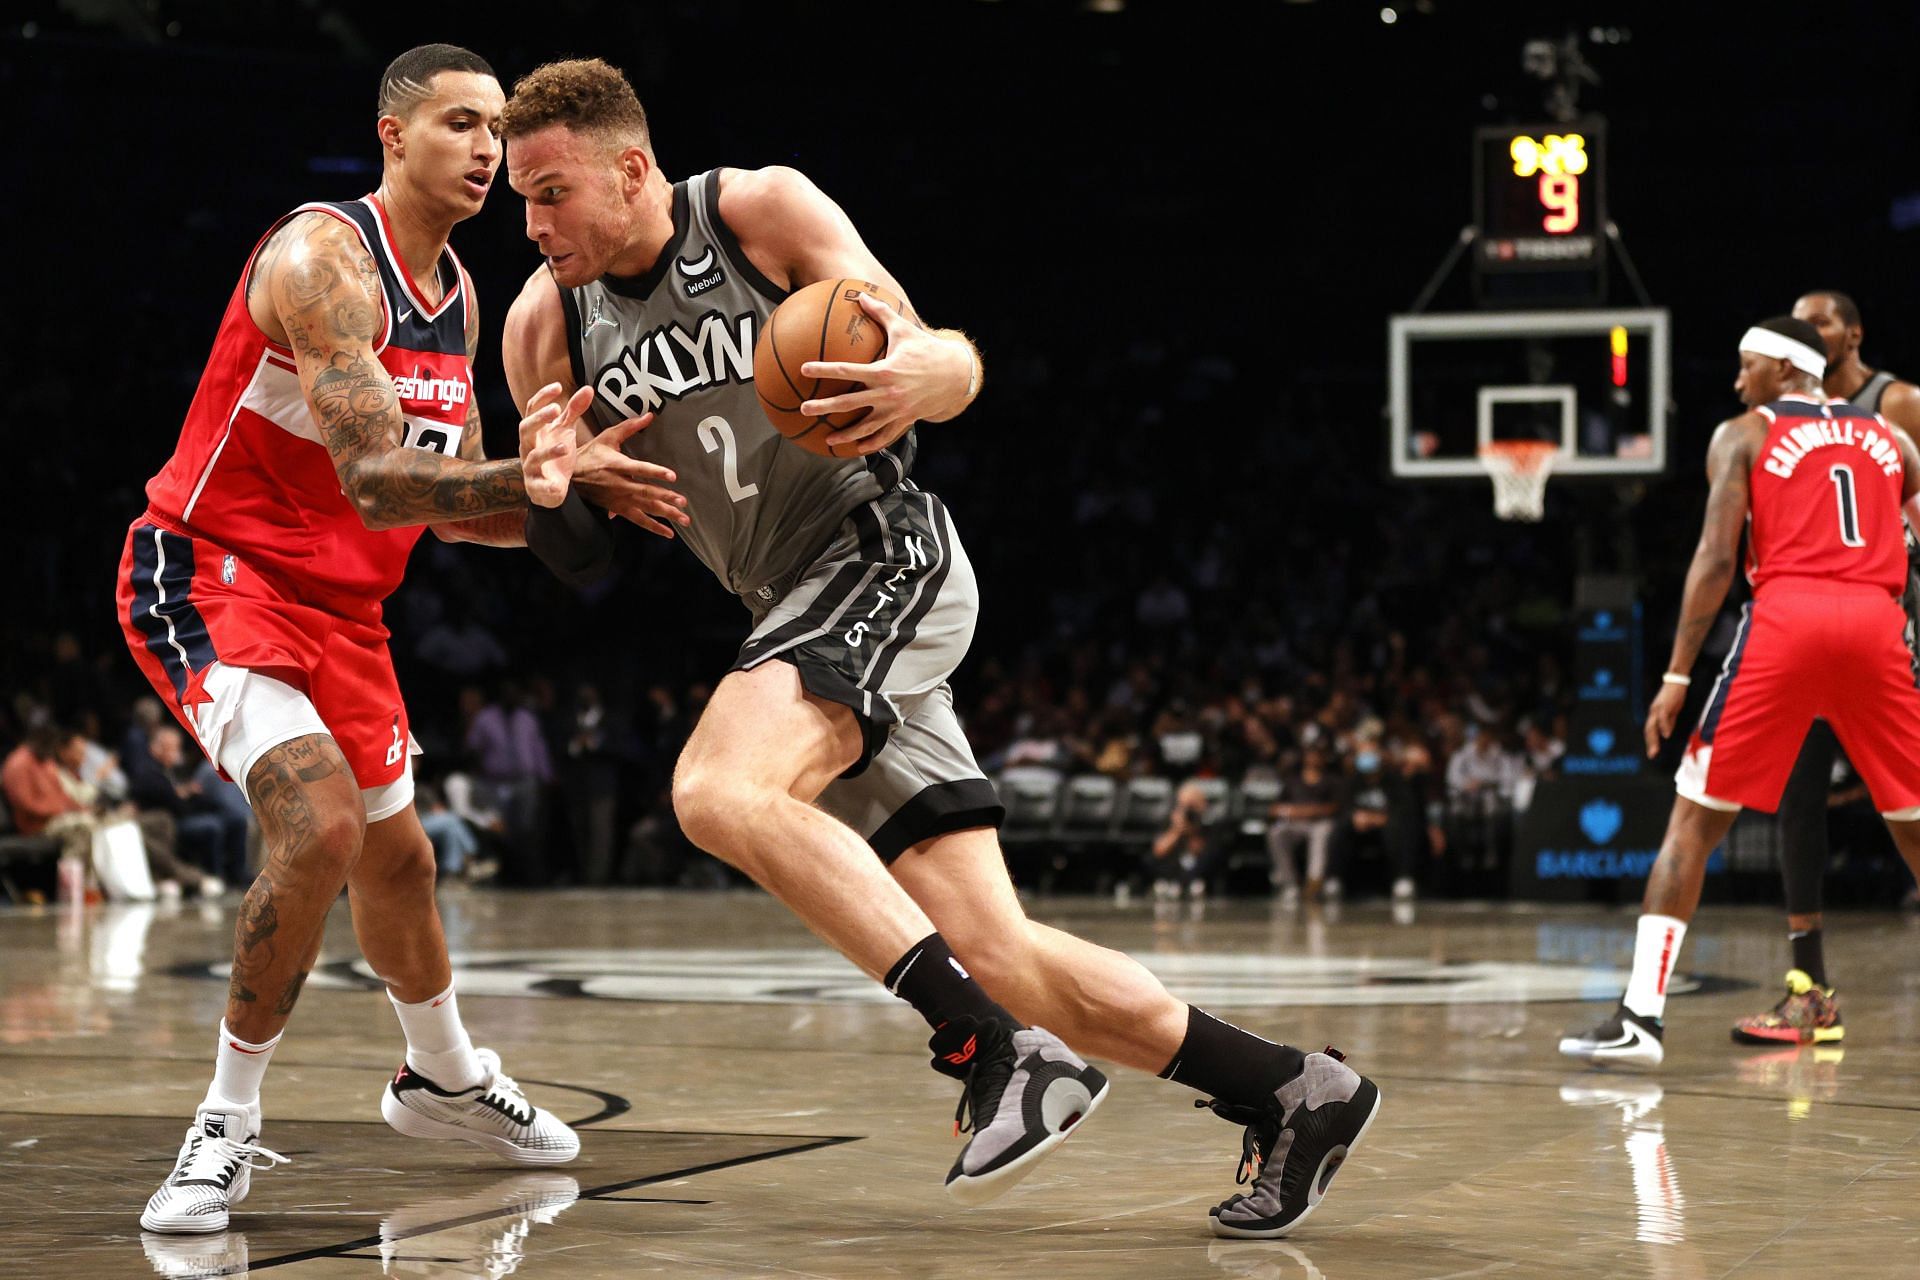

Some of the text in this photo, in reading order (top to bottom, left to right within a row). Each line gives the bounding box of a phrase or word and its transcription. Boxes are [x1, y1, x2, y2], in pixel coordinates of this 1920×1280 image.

[1540, 173, 1578, 232] 9
[687, 271, 722, 295] Webull
[393, 364, 467, 411] ashingto
[597, 314, 754, 419] BKLYN
[359, 389, 386, 409] 75
[696, 415, 760, 503] 2
[1763, 420, 1901, 479] CALDWELL-POPE
[1829, 463, 1866, 547] 1
[844, 535, 927, 648] NETS
